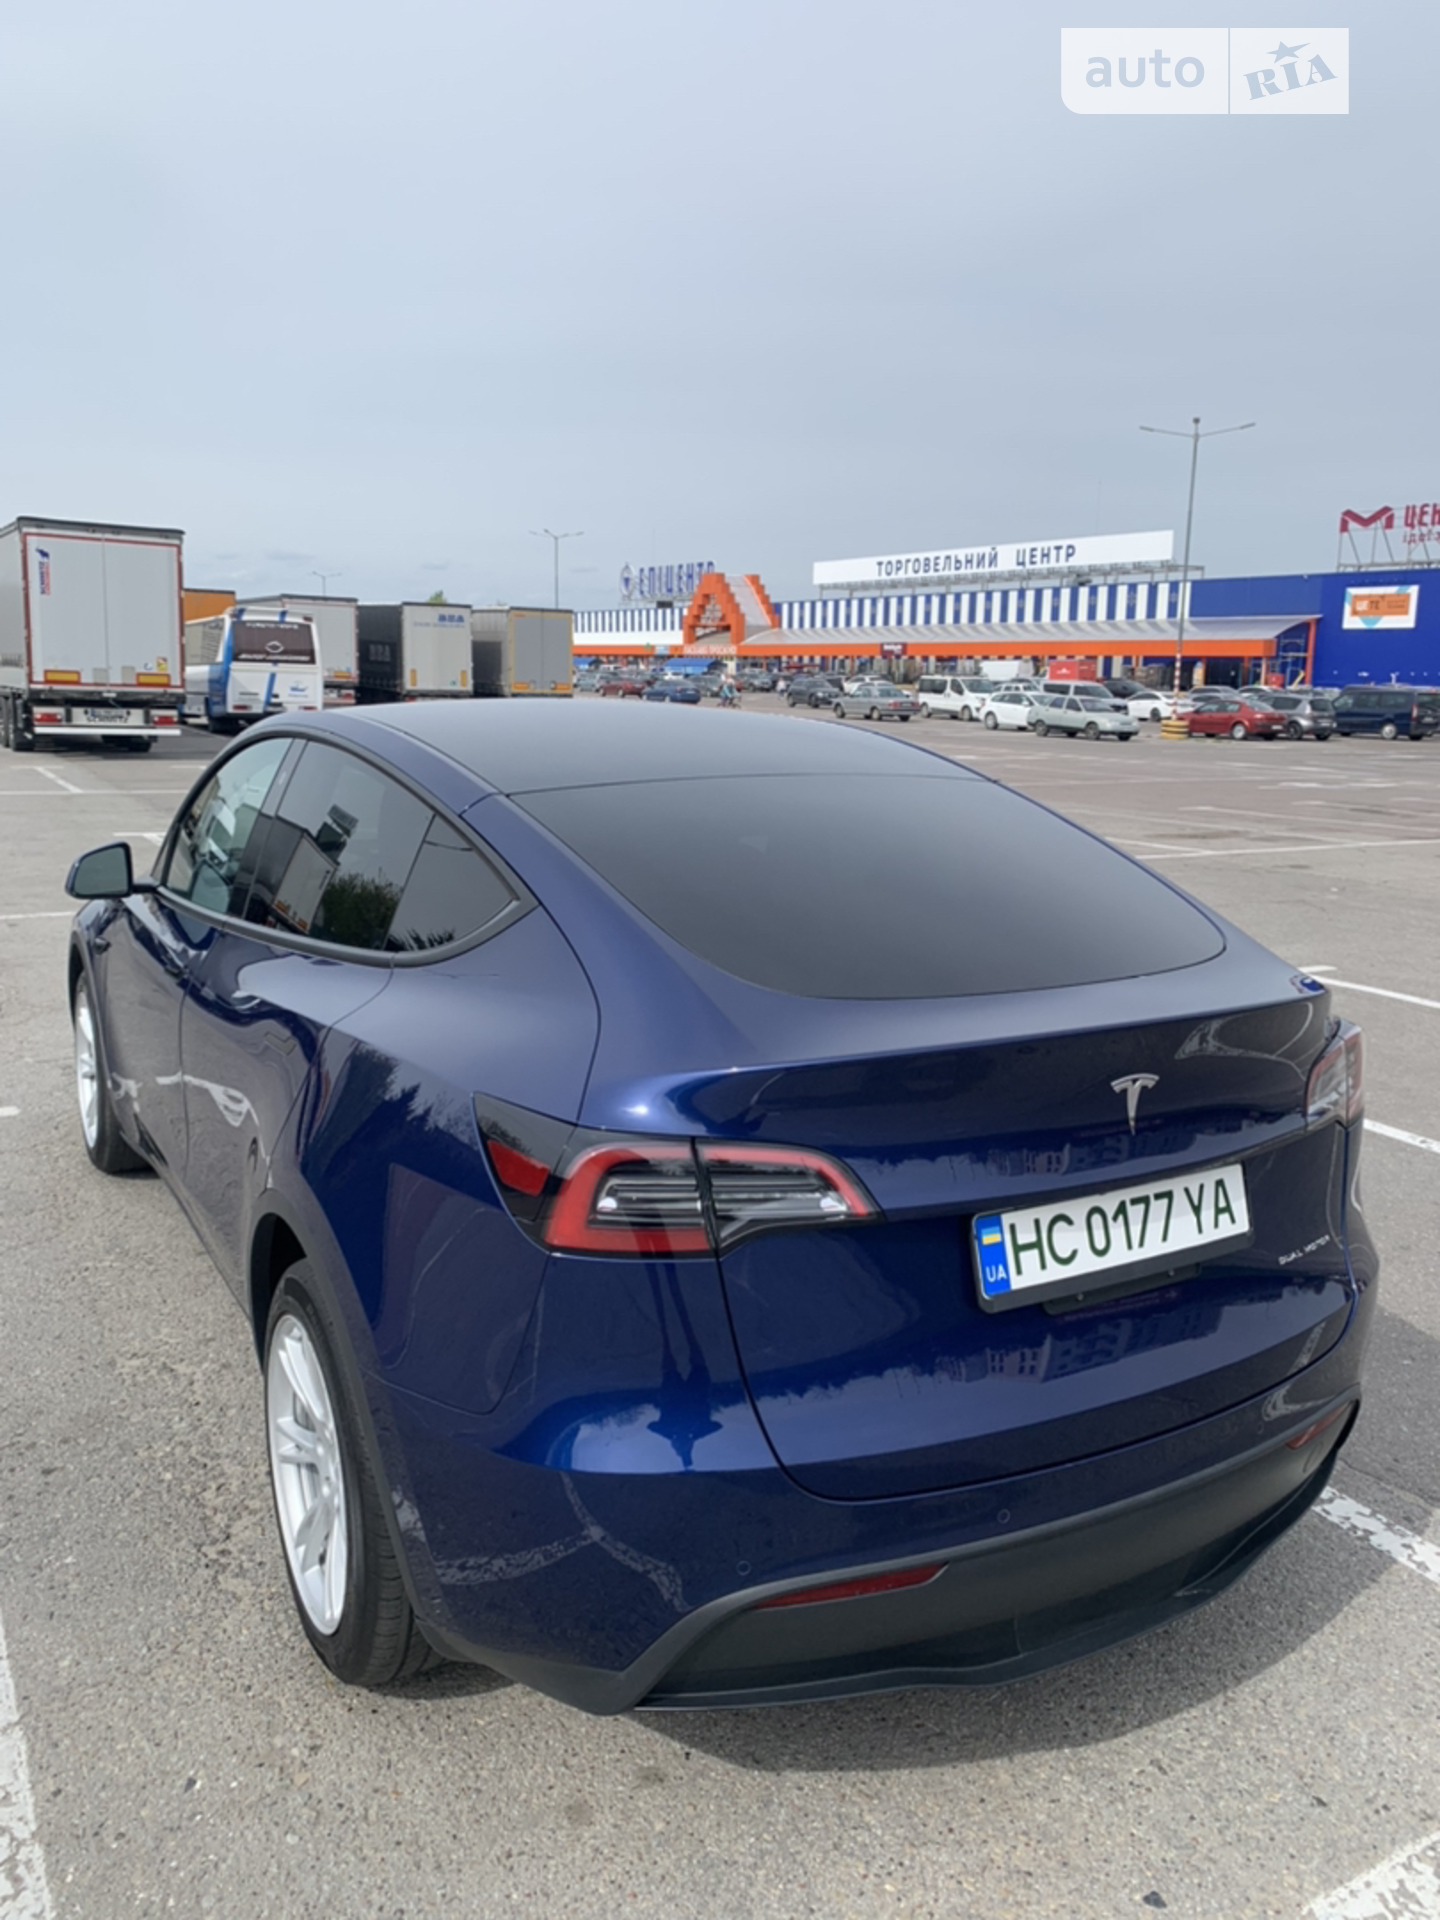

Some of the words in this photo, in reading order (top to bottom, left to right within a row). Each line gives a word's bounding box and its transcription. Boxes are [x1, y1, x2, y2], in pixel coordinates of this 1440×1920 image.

[876, 547, 998, 577] ТОРГОВЕЛЬНИЙ
[1015, 544, 1076, 568] ЦЕНТР
[986, 1264, 1007, 1283] UA
